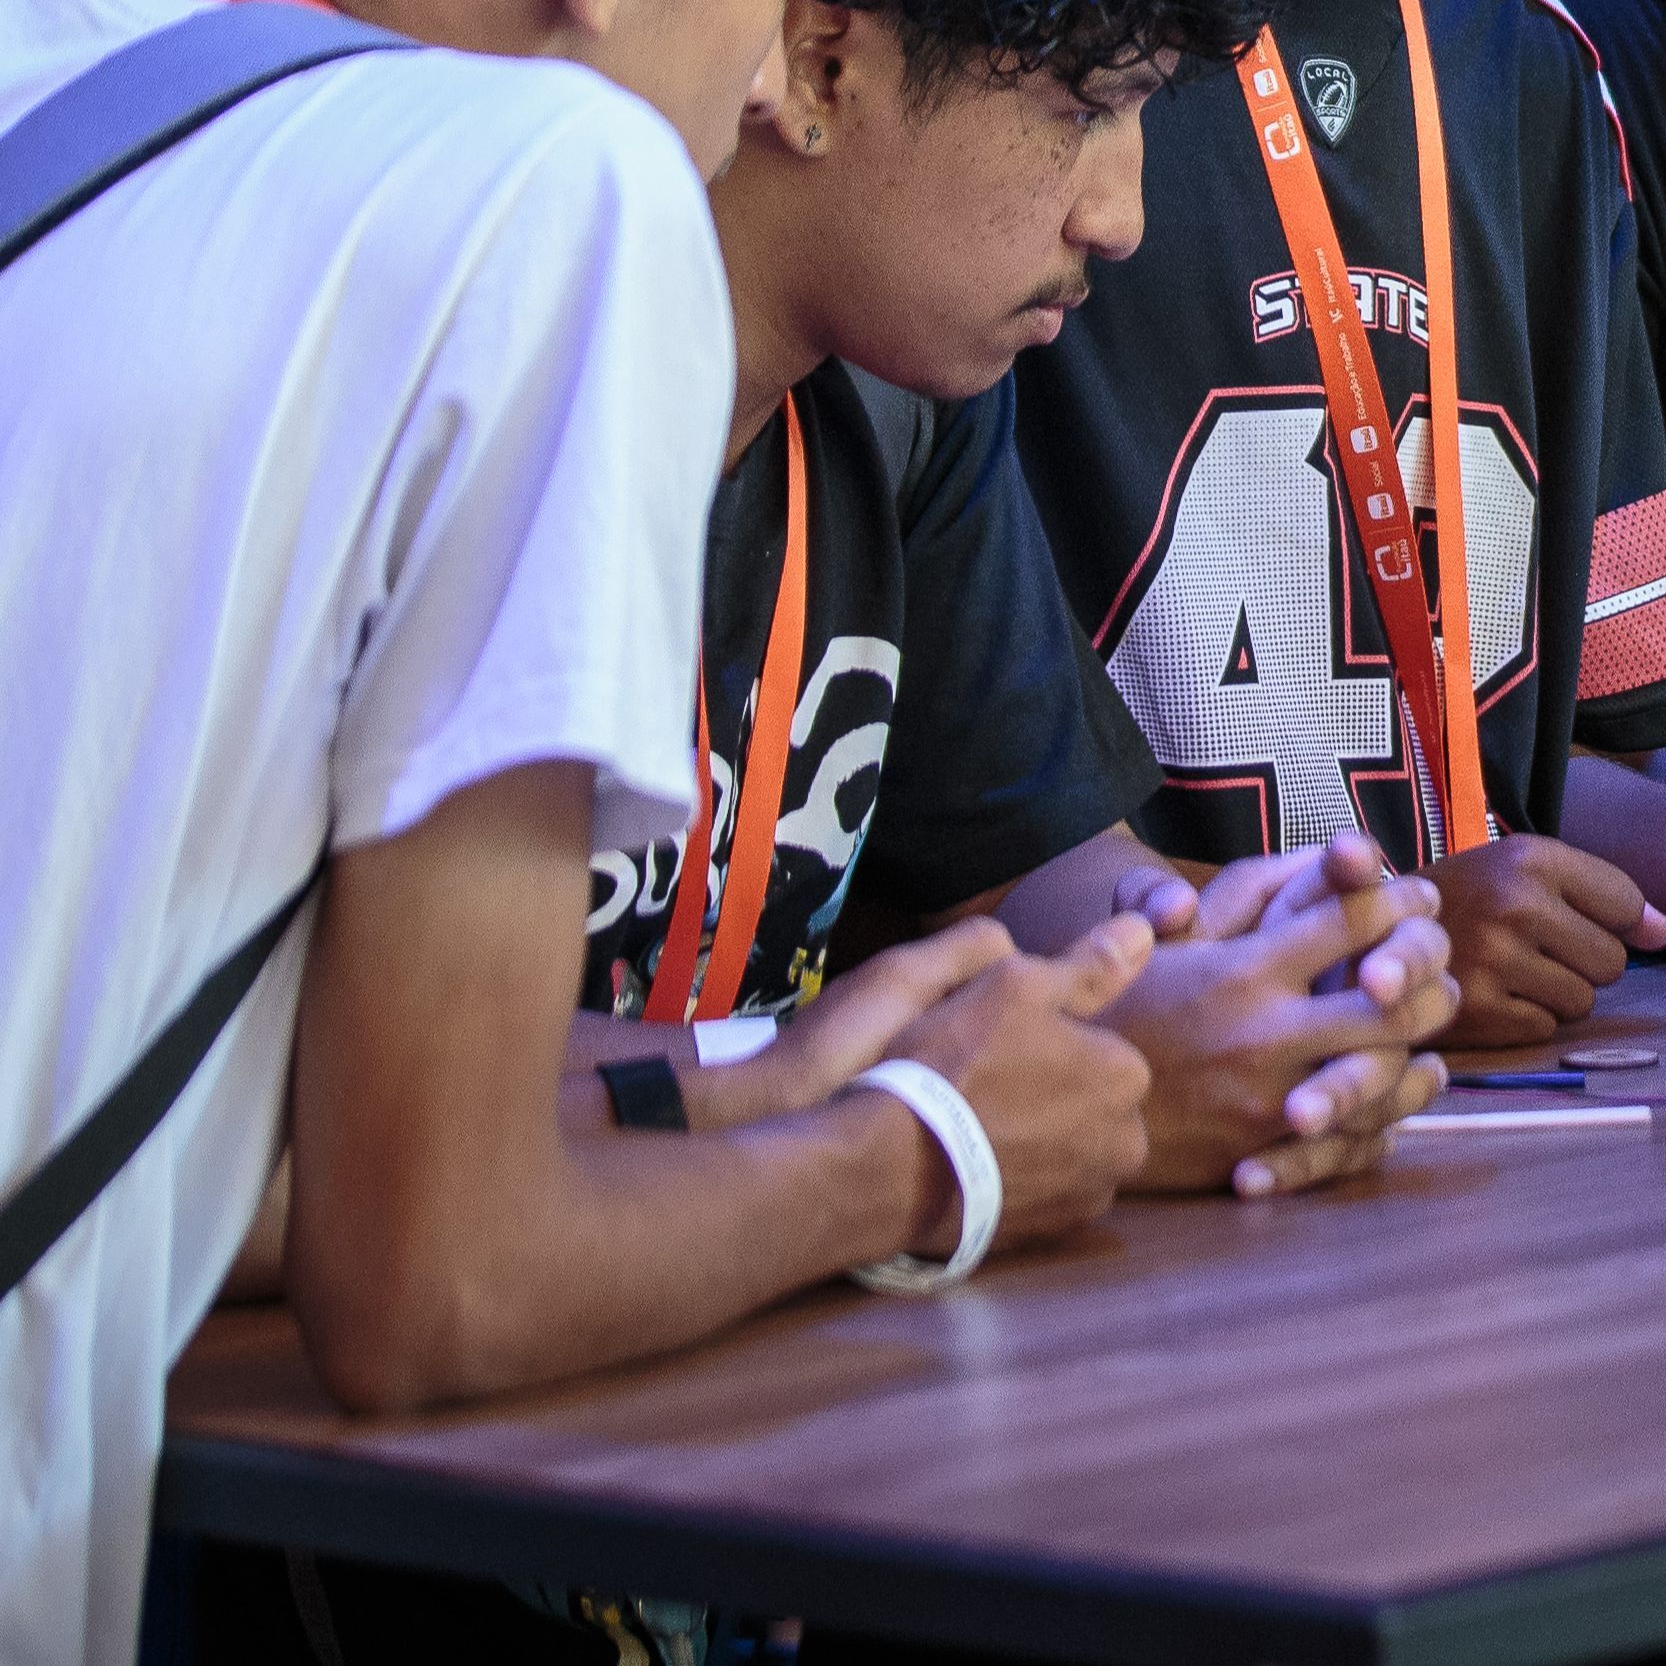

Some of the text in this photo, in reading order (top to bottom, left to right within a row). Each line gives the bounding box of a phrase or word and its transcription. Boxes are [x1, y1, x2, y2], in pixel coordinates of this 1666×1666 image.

[1307, 67, 1348, 82] LOCAL
[1316, 106, 1347, 117] SPORTS
[1250, 267, 1429, 344] SATE
[1369, 460, 1383, 487] Social
